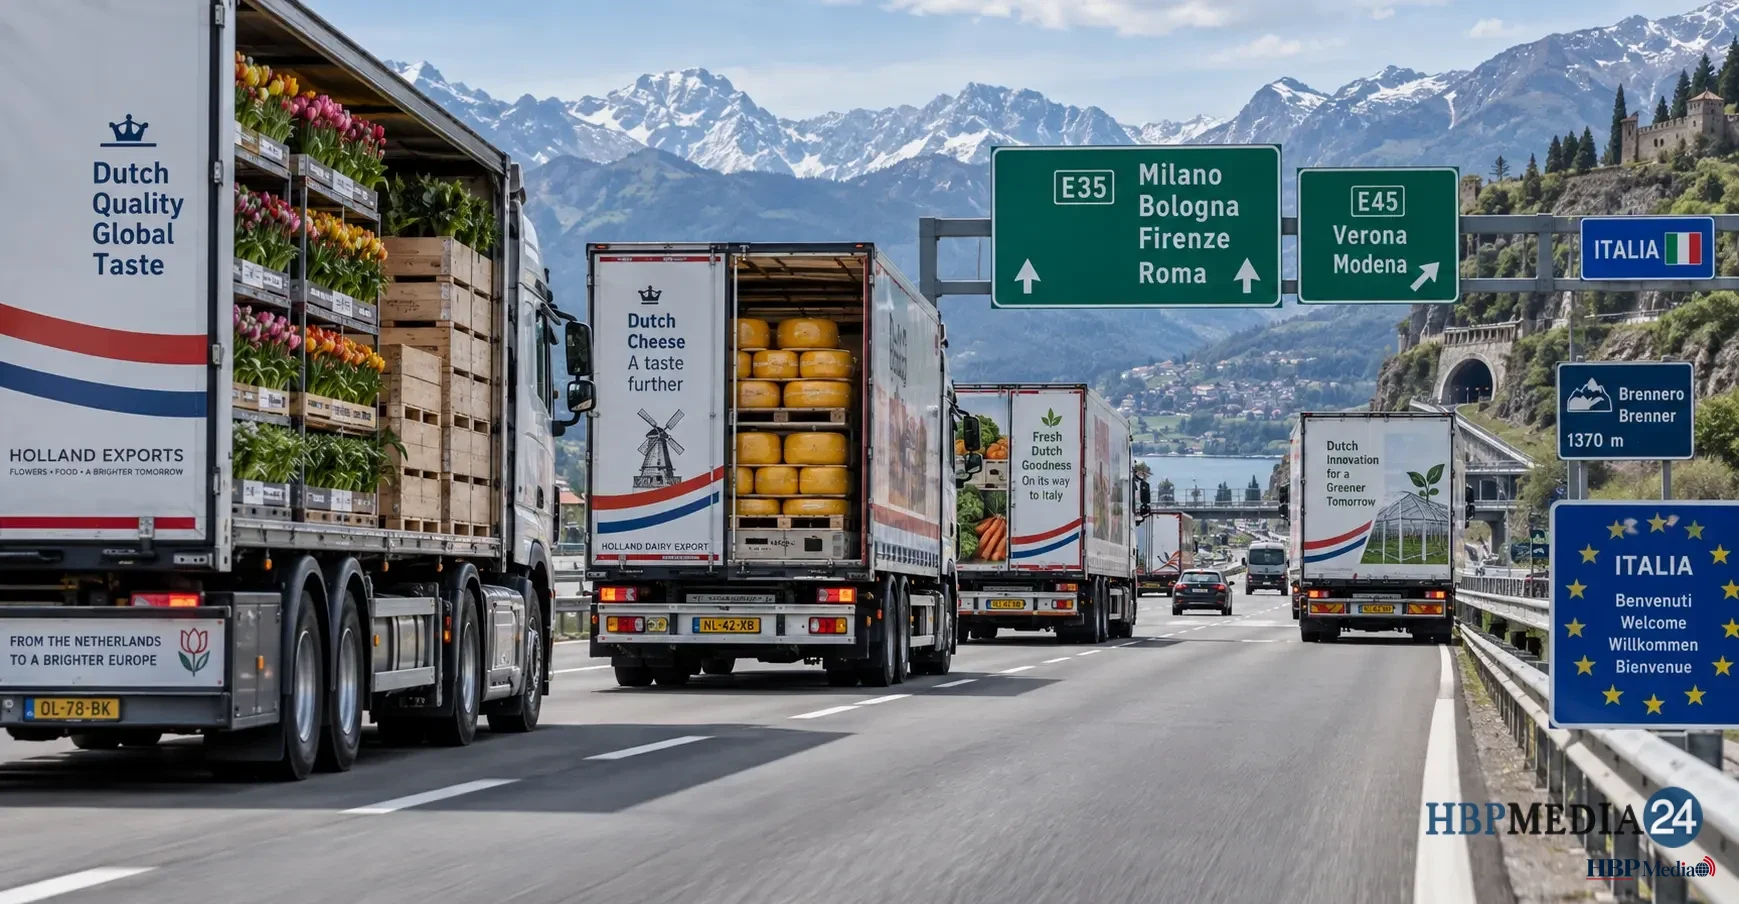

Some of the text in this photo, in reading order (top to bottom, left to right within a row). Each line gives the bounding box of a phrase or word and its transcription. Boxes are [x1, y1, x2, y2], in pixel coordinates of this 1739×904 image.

[94, 162, 168, 184] Dutch
[1140, 163, 1221, 185] Milano
[1063, 176, 1106, 198] E35
[93, 192, 184, 219] Quality
[1140, 194, 1239, 222] Bologna
[1359, 192, 1397, 211] E45
[93, 222, 174, 244] Global
[1140, 227, 1229, 249] Firenze
[1333, 225, 1406, 244] Verona
[1595, 240, 1659, 259] ITALIA
[93, 253, 164, 275] Taste
[1334, 254, 1406, 273] Modena
[1140, 262, 1206, 283] Roma
[629, 313, 675, 328] Dutch
[628, 334, 685, 349] Cheese
[628, 355, 683, 370] A taste
[628, 376, 683, 391] further
[1620, 387, 1684, 400] Brennero
[1620, 409, 1676, 422] Brenner
[1033, 431, 1062, 443] Fresh
[1568, 433, 1623, 448] 1370 m
[1032, 445, 1062, 457] Dutch
[1327, 440, 1358, 452] Dutch
[10, 449, 183, 462] HOLLAND EXPORTS
[1327, 454, 1379, 465] Innovation
[10, 467, 183, 476] FLOWERS FOOD A BRIGHTER TOMORROW
[1022, 459, 1071, 471] Goodness
[1327, 468, 1350, 479] for a
[1022, 475, 1070, 489] On its way
[1327, 482, 1365, 493] Greener
[1030, 490, 1063, 502] to Italy
[1327, 496, 1375, 507] Tomorrow
[602, 542, 709, 552] HOLLAND DAIRY EXPORT
[1616, 556, 1693, 575] ITALIA
[1616, 594, 1691, 607] Benvenuti
[703, 620, 755, 631] NL-42-XB
[1621, 616, 1686, 629] Welcome
[11, 635, 161, 647] FROM THE NETHERLANDS
[1609, 637, 1698, 651] Willkommen
[10, 654, 156, 666] TO A BRIGHTER EUROPE
[1617, 660, 1691, 673] Bienvenue
[40, 701, 111, 716] OL-78-BK
